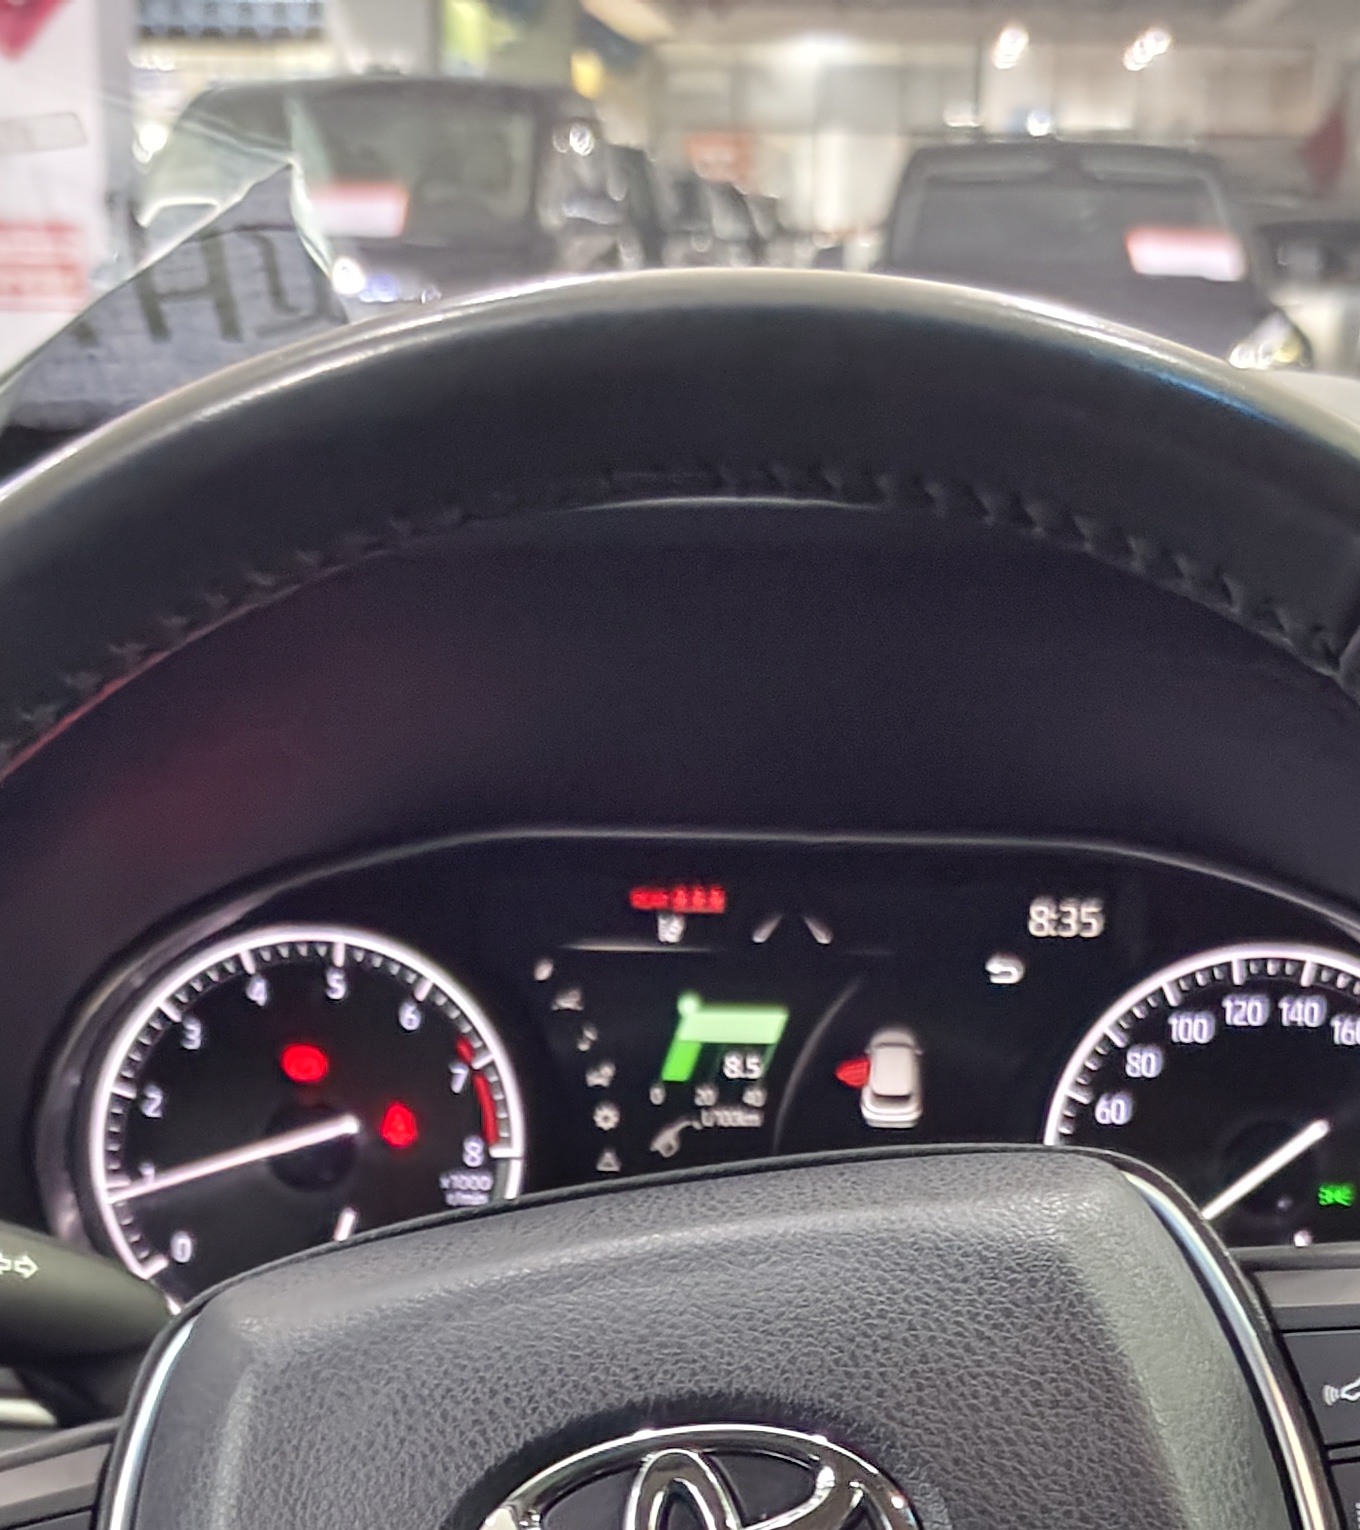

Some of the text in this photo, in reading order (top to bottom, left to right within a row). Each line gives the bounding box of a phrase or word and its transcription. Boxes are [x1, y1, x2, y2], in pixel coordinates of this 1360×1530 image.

[1028, 898, 1105, 939] 8:35
[247, 979, 268, 1005] 4
[326, 970, 346, 1001] 5
[399, 1000, 421, 1030] 6
[1222, 996, 1269, 1027] 120
[1278, 996, 1326, 1027] 140
[182, 1019, 202, 1050] 3
[1168, 1014, 1215, 1044] 100
[449, 1063, 468, 1093] 7
[1125, 1049, 1163, 1079] 80
[143, 1086, 163, 1118] 2
[1094, 1095, 1132, 1126] 60
[463, 1137, 485, 1167] 8
[172, 1232, 194, 1263] 0
